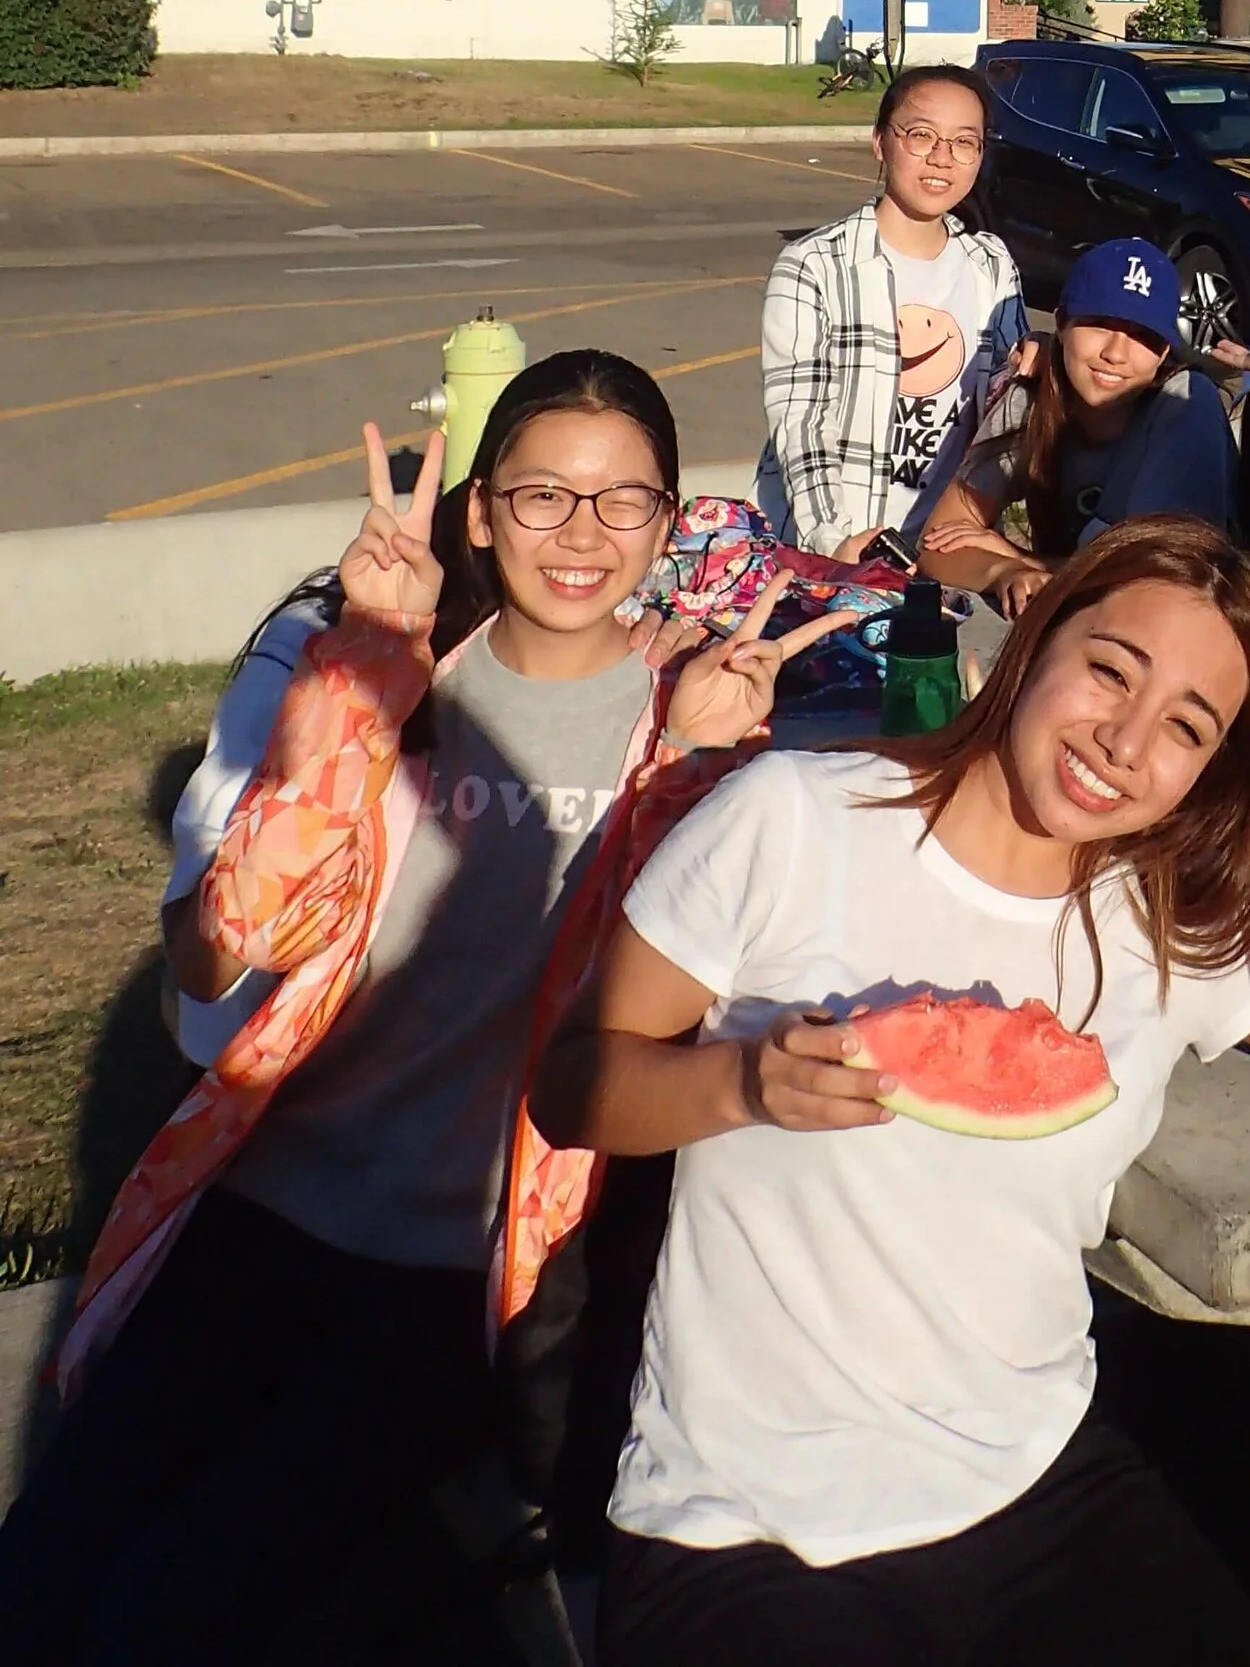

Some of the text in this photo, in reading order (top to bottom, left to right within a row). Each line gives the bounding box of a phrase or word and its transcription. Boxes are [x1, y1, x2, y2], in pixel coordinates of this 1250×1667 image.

[1123, 256, 1152, 298] LA
[941, 398, 960, 427] A
[892, 426, 942, 459] IKE
[889, 457, 932, 490] AY.
